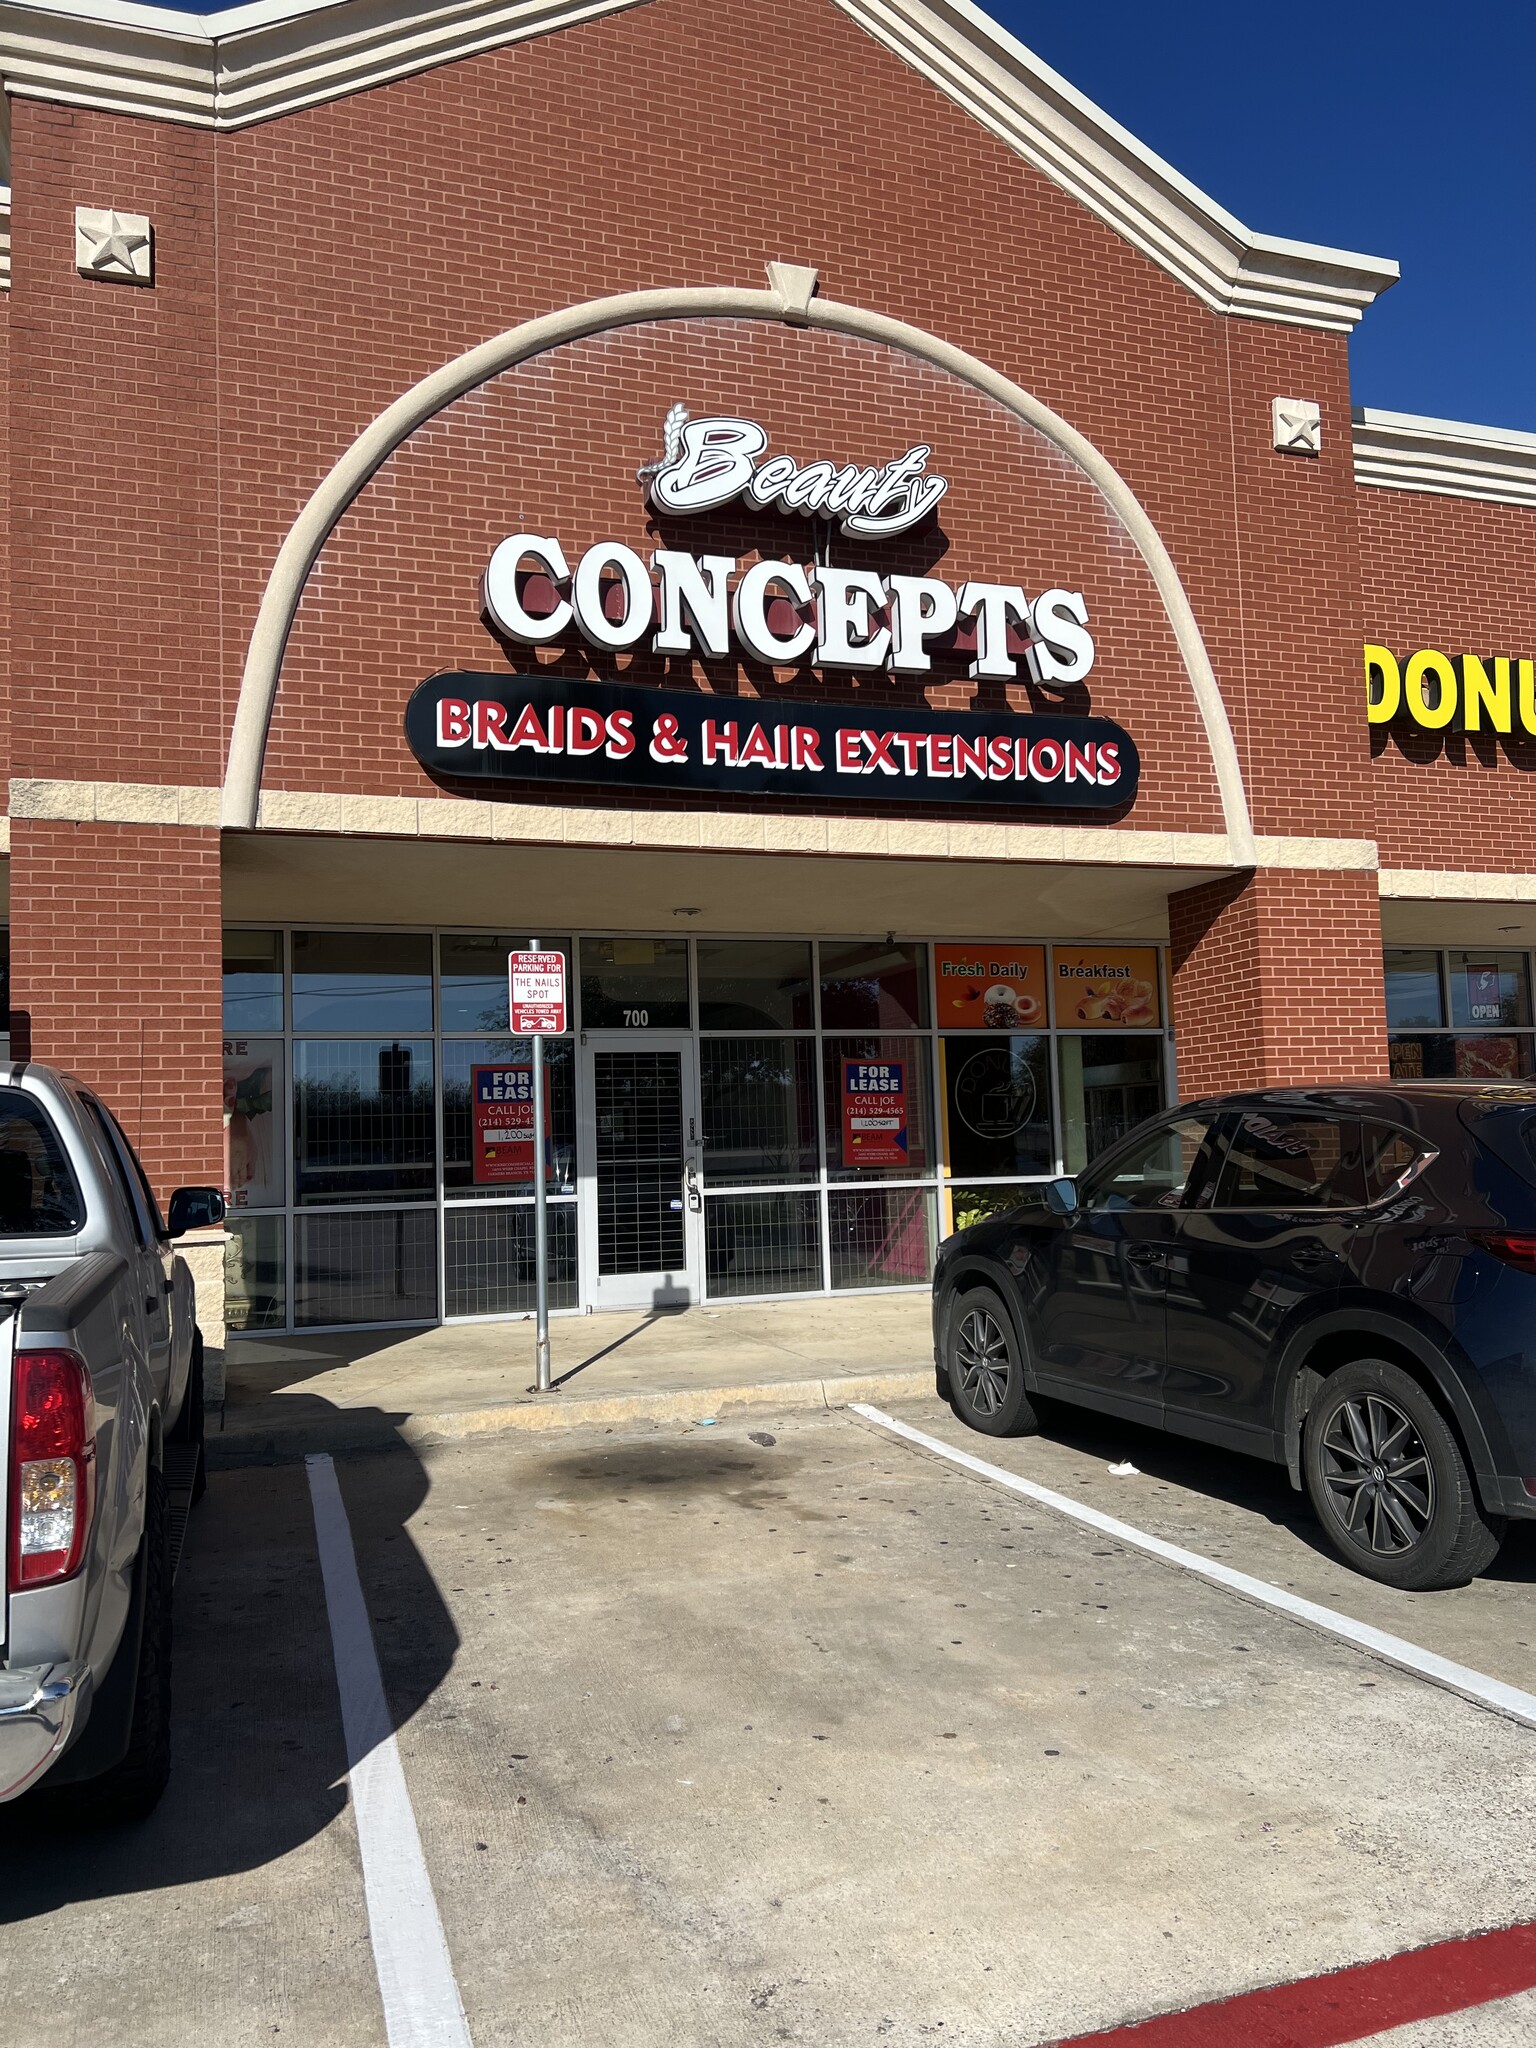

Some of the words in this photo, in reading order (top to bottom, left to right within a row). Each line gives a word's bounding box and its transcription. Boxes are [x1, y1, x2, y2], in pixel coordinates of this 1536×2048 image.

[652, 416, 948, 540] Beauty
[485, 532, 1096, 687] CONCEPTS
[436, 698, 636, 761] BRAIDS
[649, 712, 689, 761] &
[702, 718, 824, 772] HAIR
[836, 728, 1121, 786] EXTENSIONS
[518, 954, 557, 963] RESERVED
[513, 963, 544, 972] PARKING
[547, 964, 561, 972] FOR
[941, 961, 985, 977] Fresh
[989, 962, 1028, 981] Daily
[1058, 963, 1131, 979] Breakfast
[515, 977, 531, 987] THE
[535, 978, 560, 987] NAILS
[527, 989, 549, 999] SPOT
[623, 1009, 649, 1027] 700
[1471, 1004, 1500, 1019] OPEN
[1390, 1042, 1422, 1060] PEN
[858, 1066, 890, 1078] FOR
[493, 1072, 530, 1086] FOR
[850, 1079, 899, 1091] LEASE
[482, 1086, 534, 1100] LEAS
[854, 1096, 877, 1105] CALL
[880, 1096, 896, 1106] JOE
[488, 1105, 515, 1115] CALL
[846, 1107, 867, 1116] (214)
[869, 1107, 904, 1115] 529-4565
[478, 1118, 502, 1128] (214)
